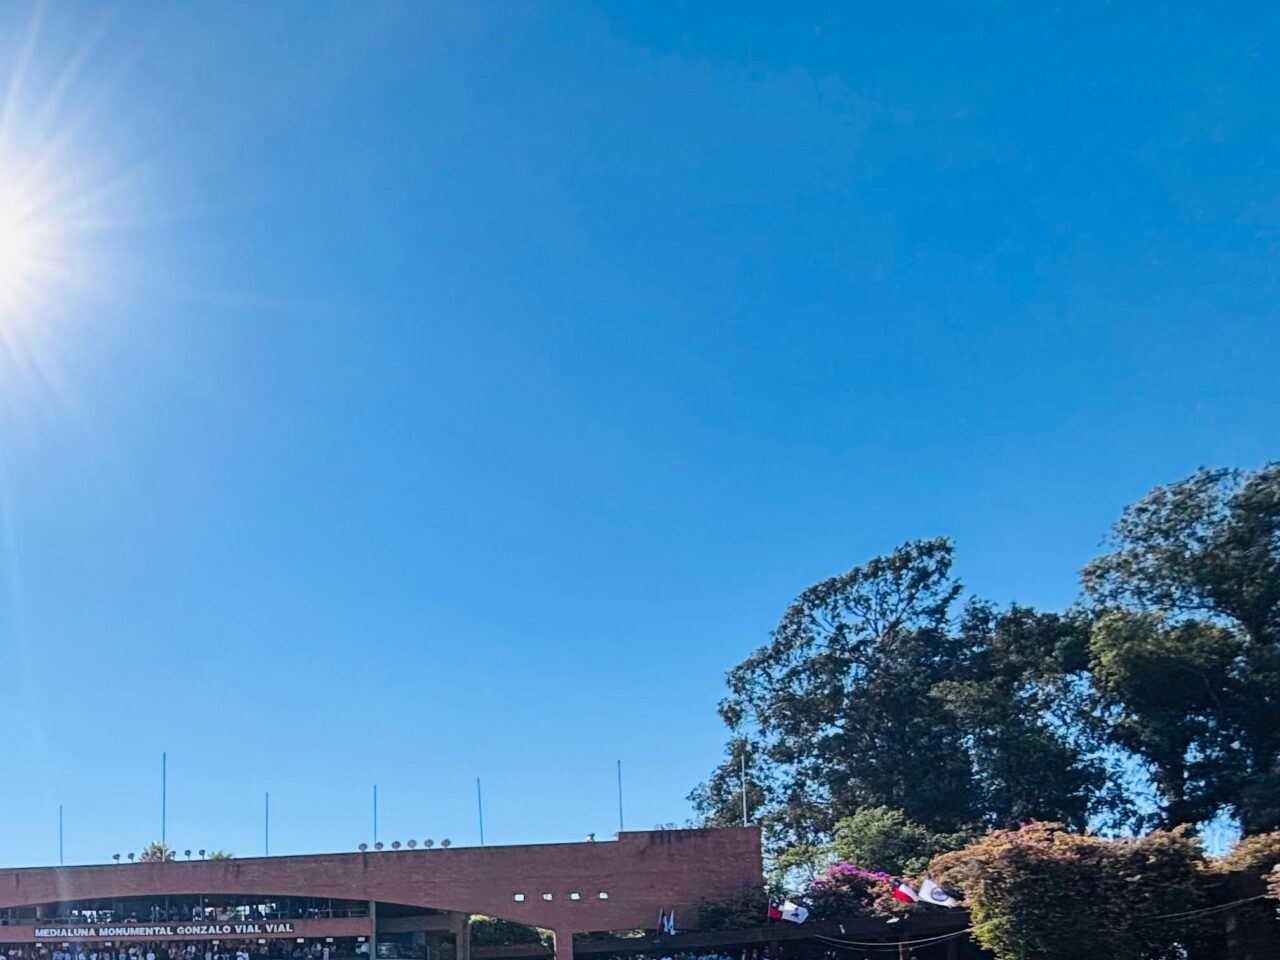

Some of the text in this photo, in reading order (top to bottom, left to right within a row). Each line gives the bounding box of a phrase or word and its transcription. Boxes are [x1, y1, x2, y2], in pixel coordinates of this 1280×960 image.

[35, 923, 293, 937] MEDIALUNA MONUMENTAL GONZALO VIAL VIAL
